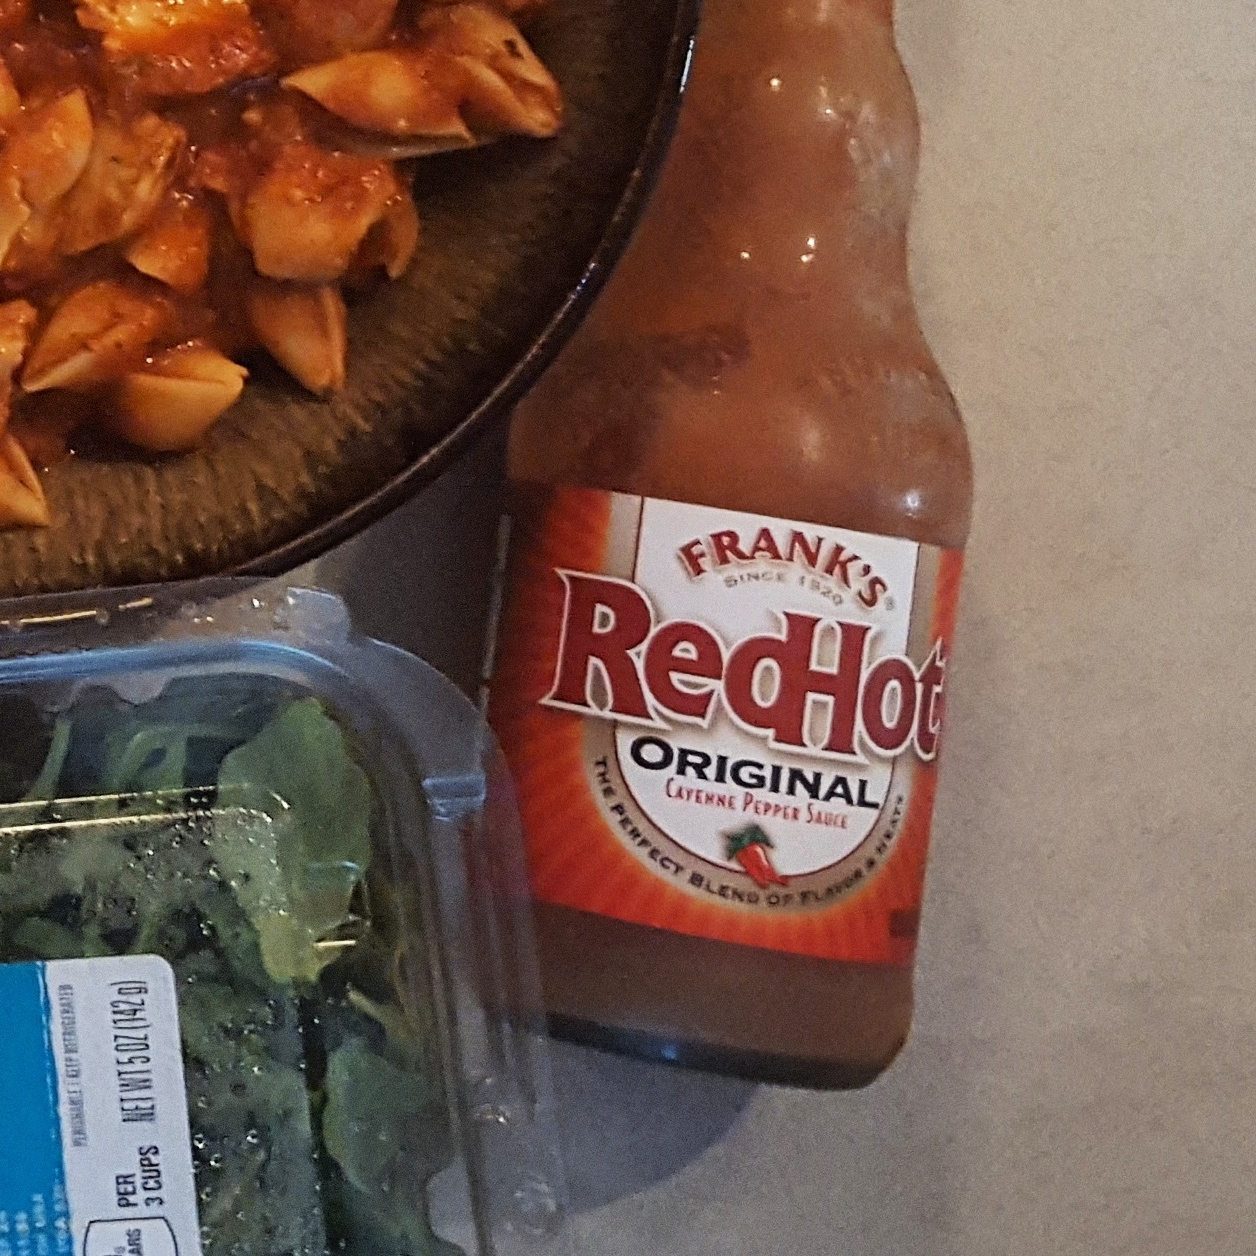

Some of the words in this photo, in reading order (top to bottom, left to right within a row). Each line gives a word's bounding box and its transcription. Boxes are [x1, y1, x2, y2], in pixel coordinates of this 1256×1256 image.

[676, 525, 890, 610] FRANK'S
[540, 568, 946, 764] RedHot
[629, 735, 881, 811] ORIGINAL
[595, 756, 615, 799] THE
[610, 801, 684, 875] PERFECT
[687, 871, 760, 905] BLEND
[113, 1033, 151, 1053] OZ
[116, 1069, 153, 1094] WT
[119, 1095, 156, 1123] NET
[137, 1144, 161, 1187] CUPS
[115, 1172, 140, 1209] PER
[144, 1189, 165, 1207] 3
